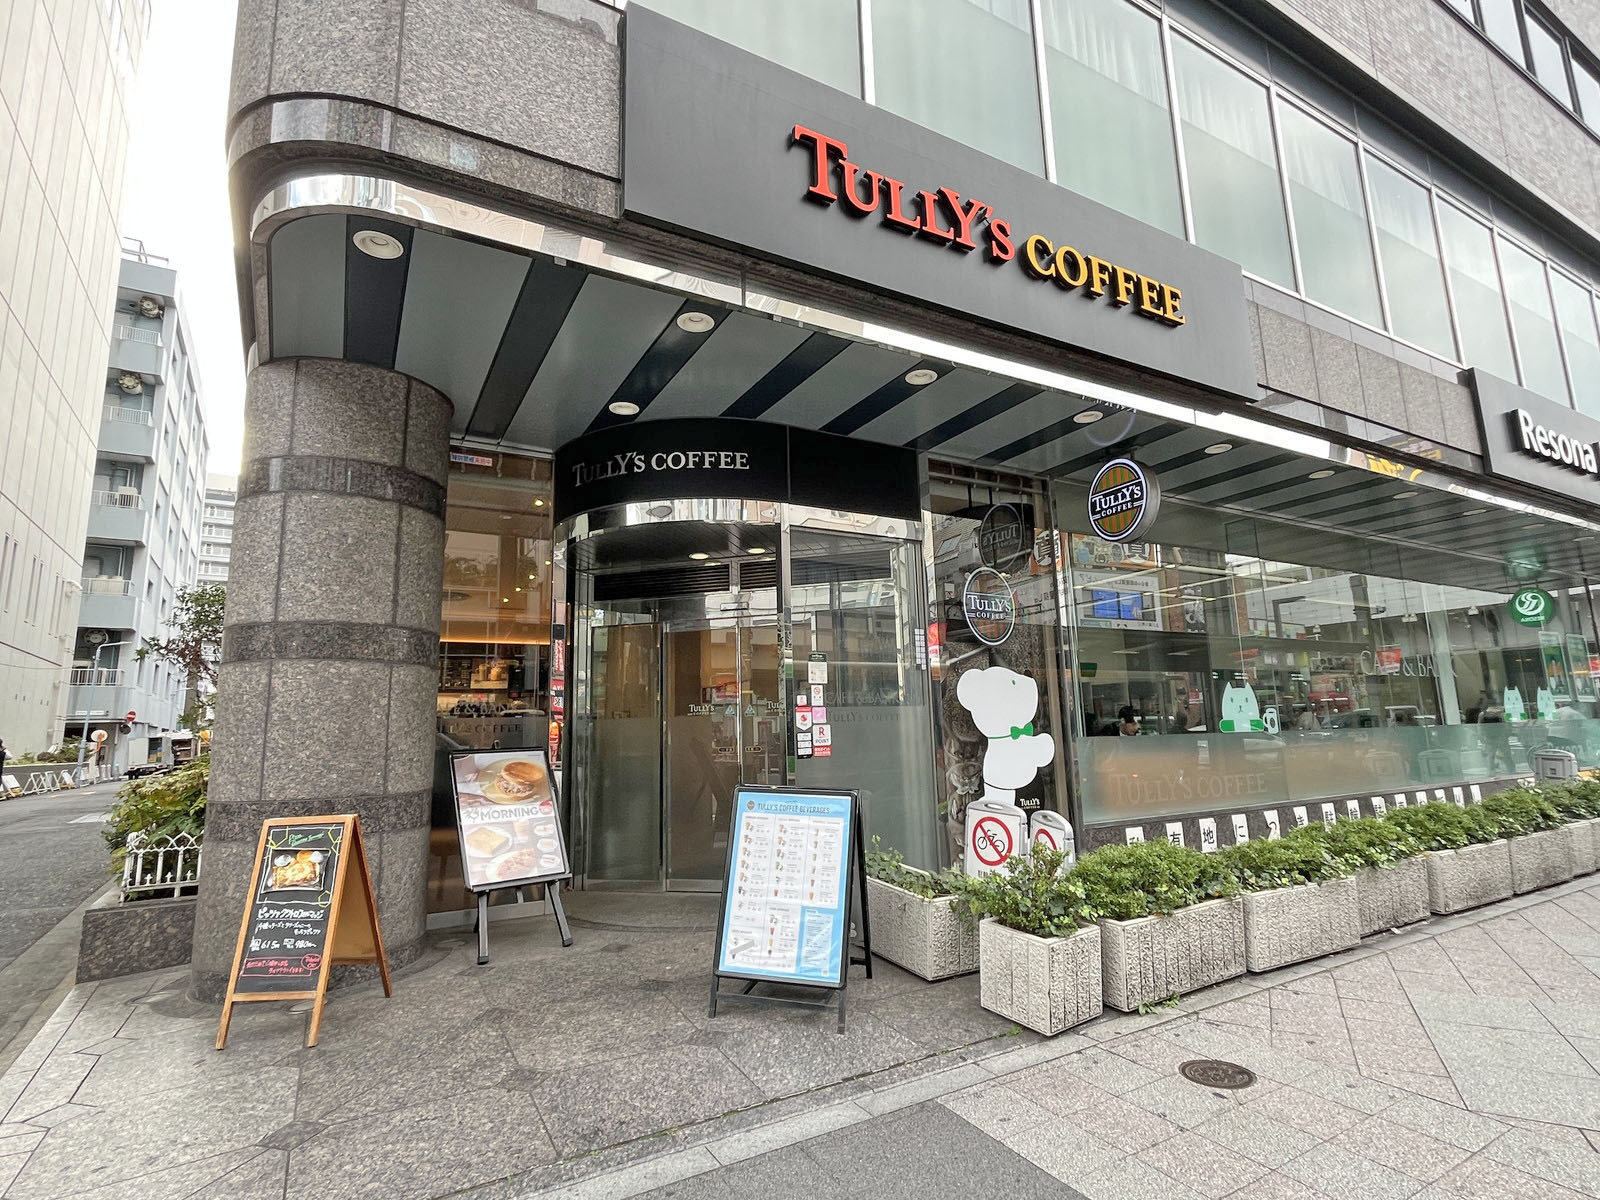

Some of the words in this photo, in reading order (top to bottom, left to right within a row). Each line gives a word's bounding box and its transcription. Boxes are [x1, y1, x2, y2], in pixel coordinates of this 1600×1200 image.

[794, 124, 1015, 262] TULLY'S
[1026, 234, 1186, 326] COFFEE
[1517, 408, 1598, 474] Resona
[572, 451, 646, 487] TULLY'S
[651, 451, 750, 471] COFFEE
[1092, 484, 1142, 512] TULLY'S
[1101, 501, 1133, 517] COFFEE
[967, 594, 1011, 613] TULLY'S
[976, 612, 1006, 620] COFFEE
[1197, 773, 1268, 799] COFFEE
[480, 806, 539, 821] MORNING
[779, 804, 798, 813] COFFEE
[799, 805, 830, 814] BEVERAGES
